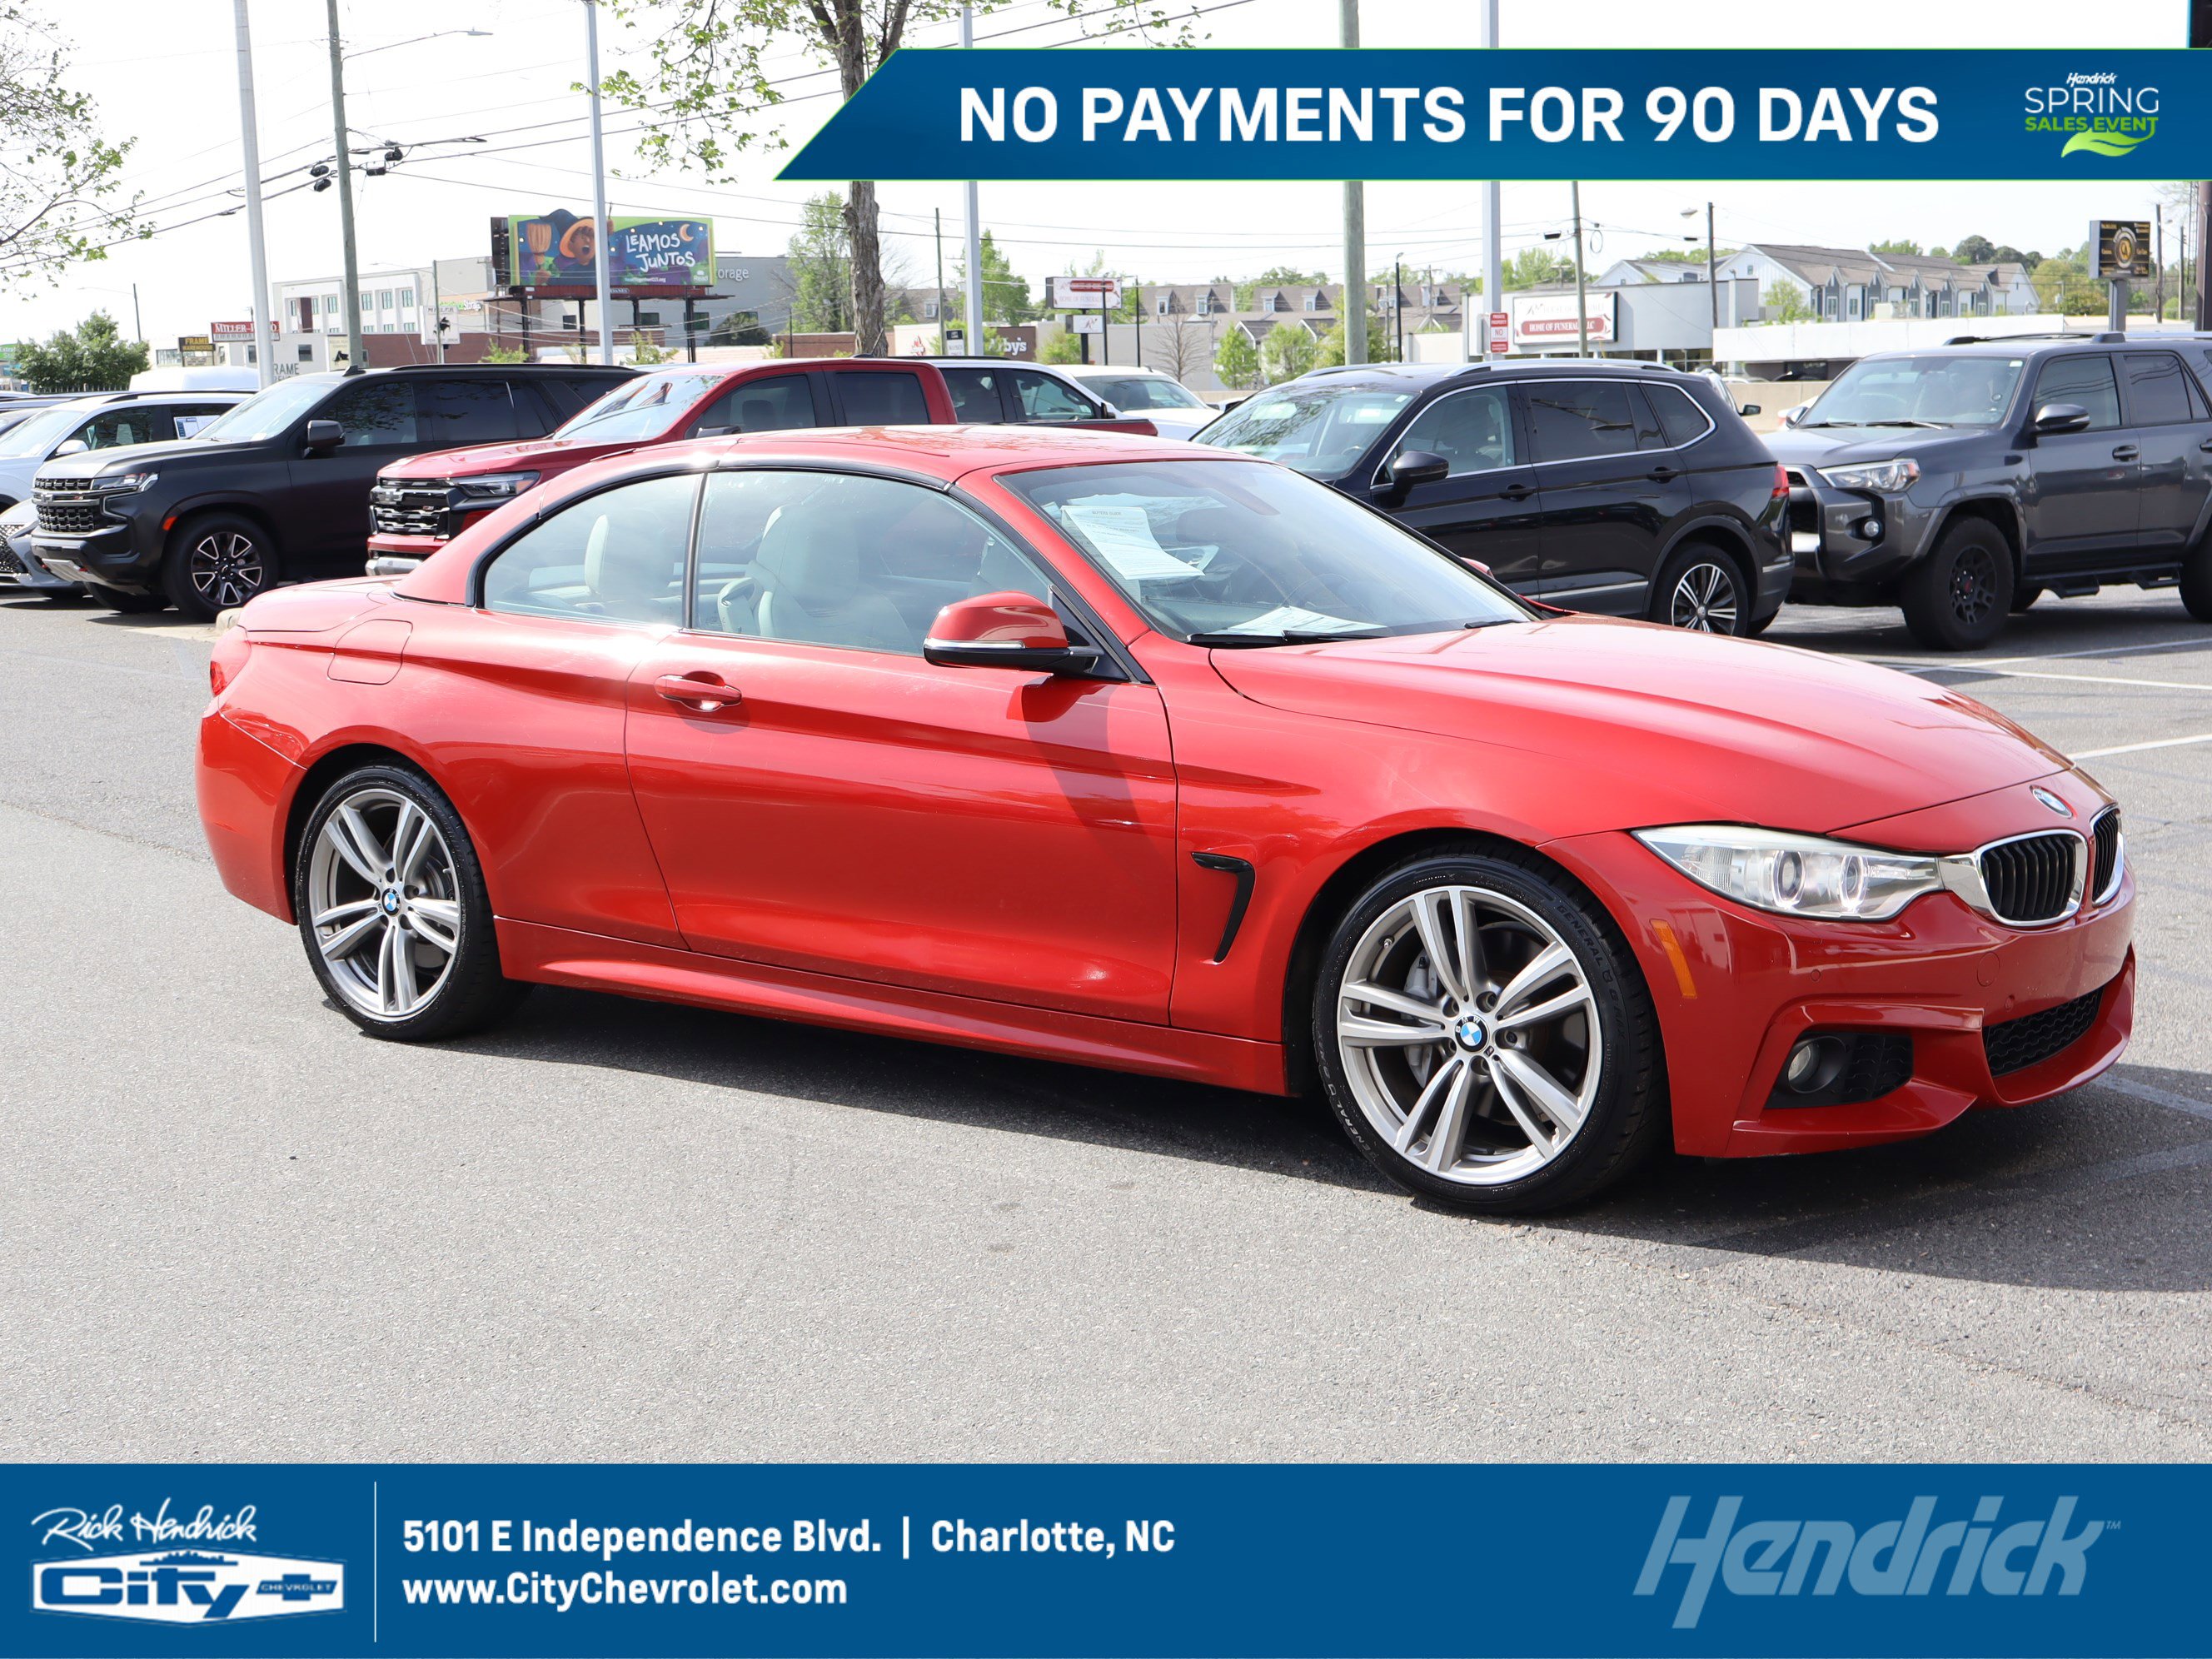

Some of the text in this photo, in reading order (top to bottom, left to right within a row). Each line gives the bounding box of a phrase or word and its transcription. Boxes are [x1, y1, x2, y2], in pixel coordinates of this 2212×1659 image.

[625, 232, 680, 253] LEAMOS
[635, 251, 696, 273] JUNTOS
[717, 269, 749, 281] orage
[1529, 323, 1545, 331] HOME
[1545, 323, 1553, 331] OF
[185, 336, 209, 345] FRAME
[273, 363, 300, 375] RAME
[1556, 904, 1606, 967] GENERAL
